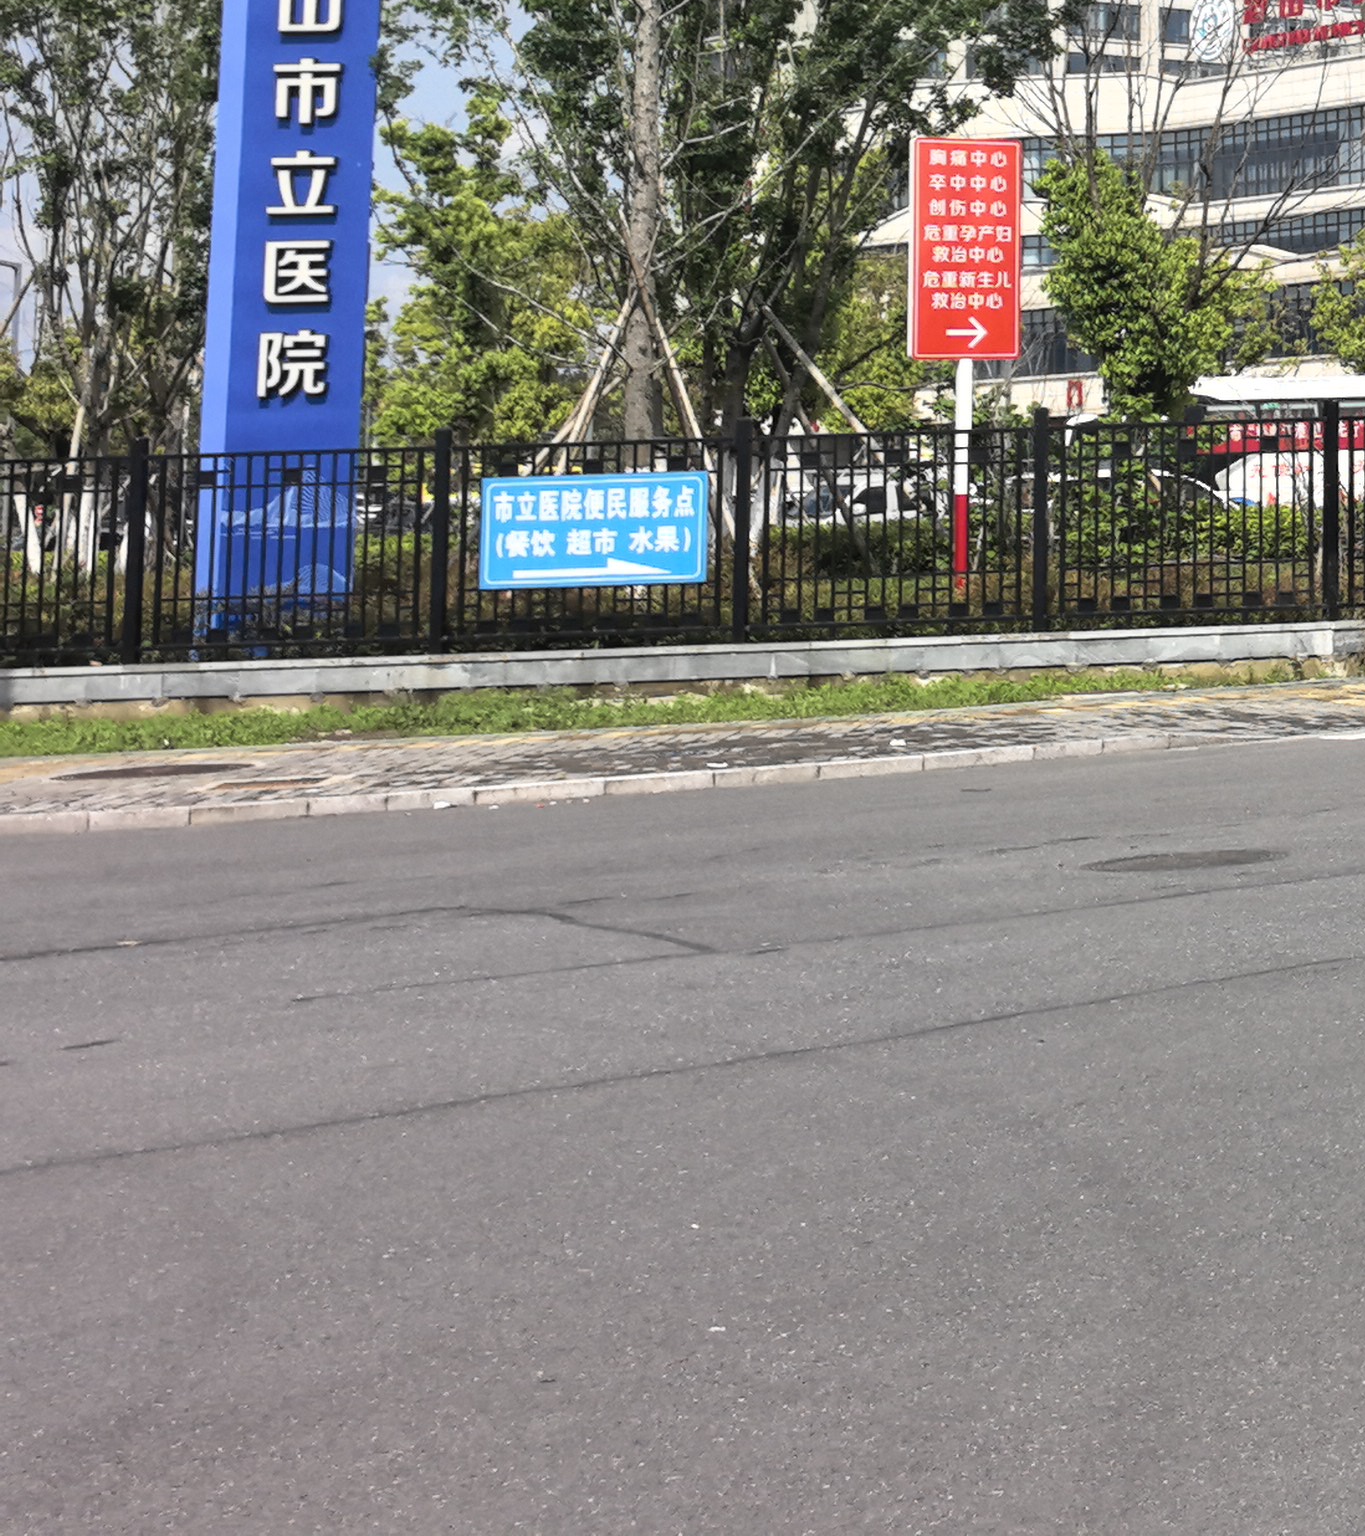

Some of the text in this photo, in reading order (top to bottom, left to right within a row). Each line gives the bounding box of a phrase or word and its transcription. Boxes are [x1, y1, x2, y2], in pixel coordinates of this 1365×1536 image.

[929, 149, 1007, 168] 胸痛中心
[928, 174, 1007, 192] 卒中中心
[928, 199, 1007, 217] 创伤中心
[924, 225, 1012, 242] 危重孕产妇
[932, 245, 1004, 263] 救治中心
[923, 271, 1012, 289] 危重新生儿
[931, 292, 1003, 310] 救治中心
[493, 485, 696, 523] 市立医院便民服务点
[566, 527, 618, 555] 超市
